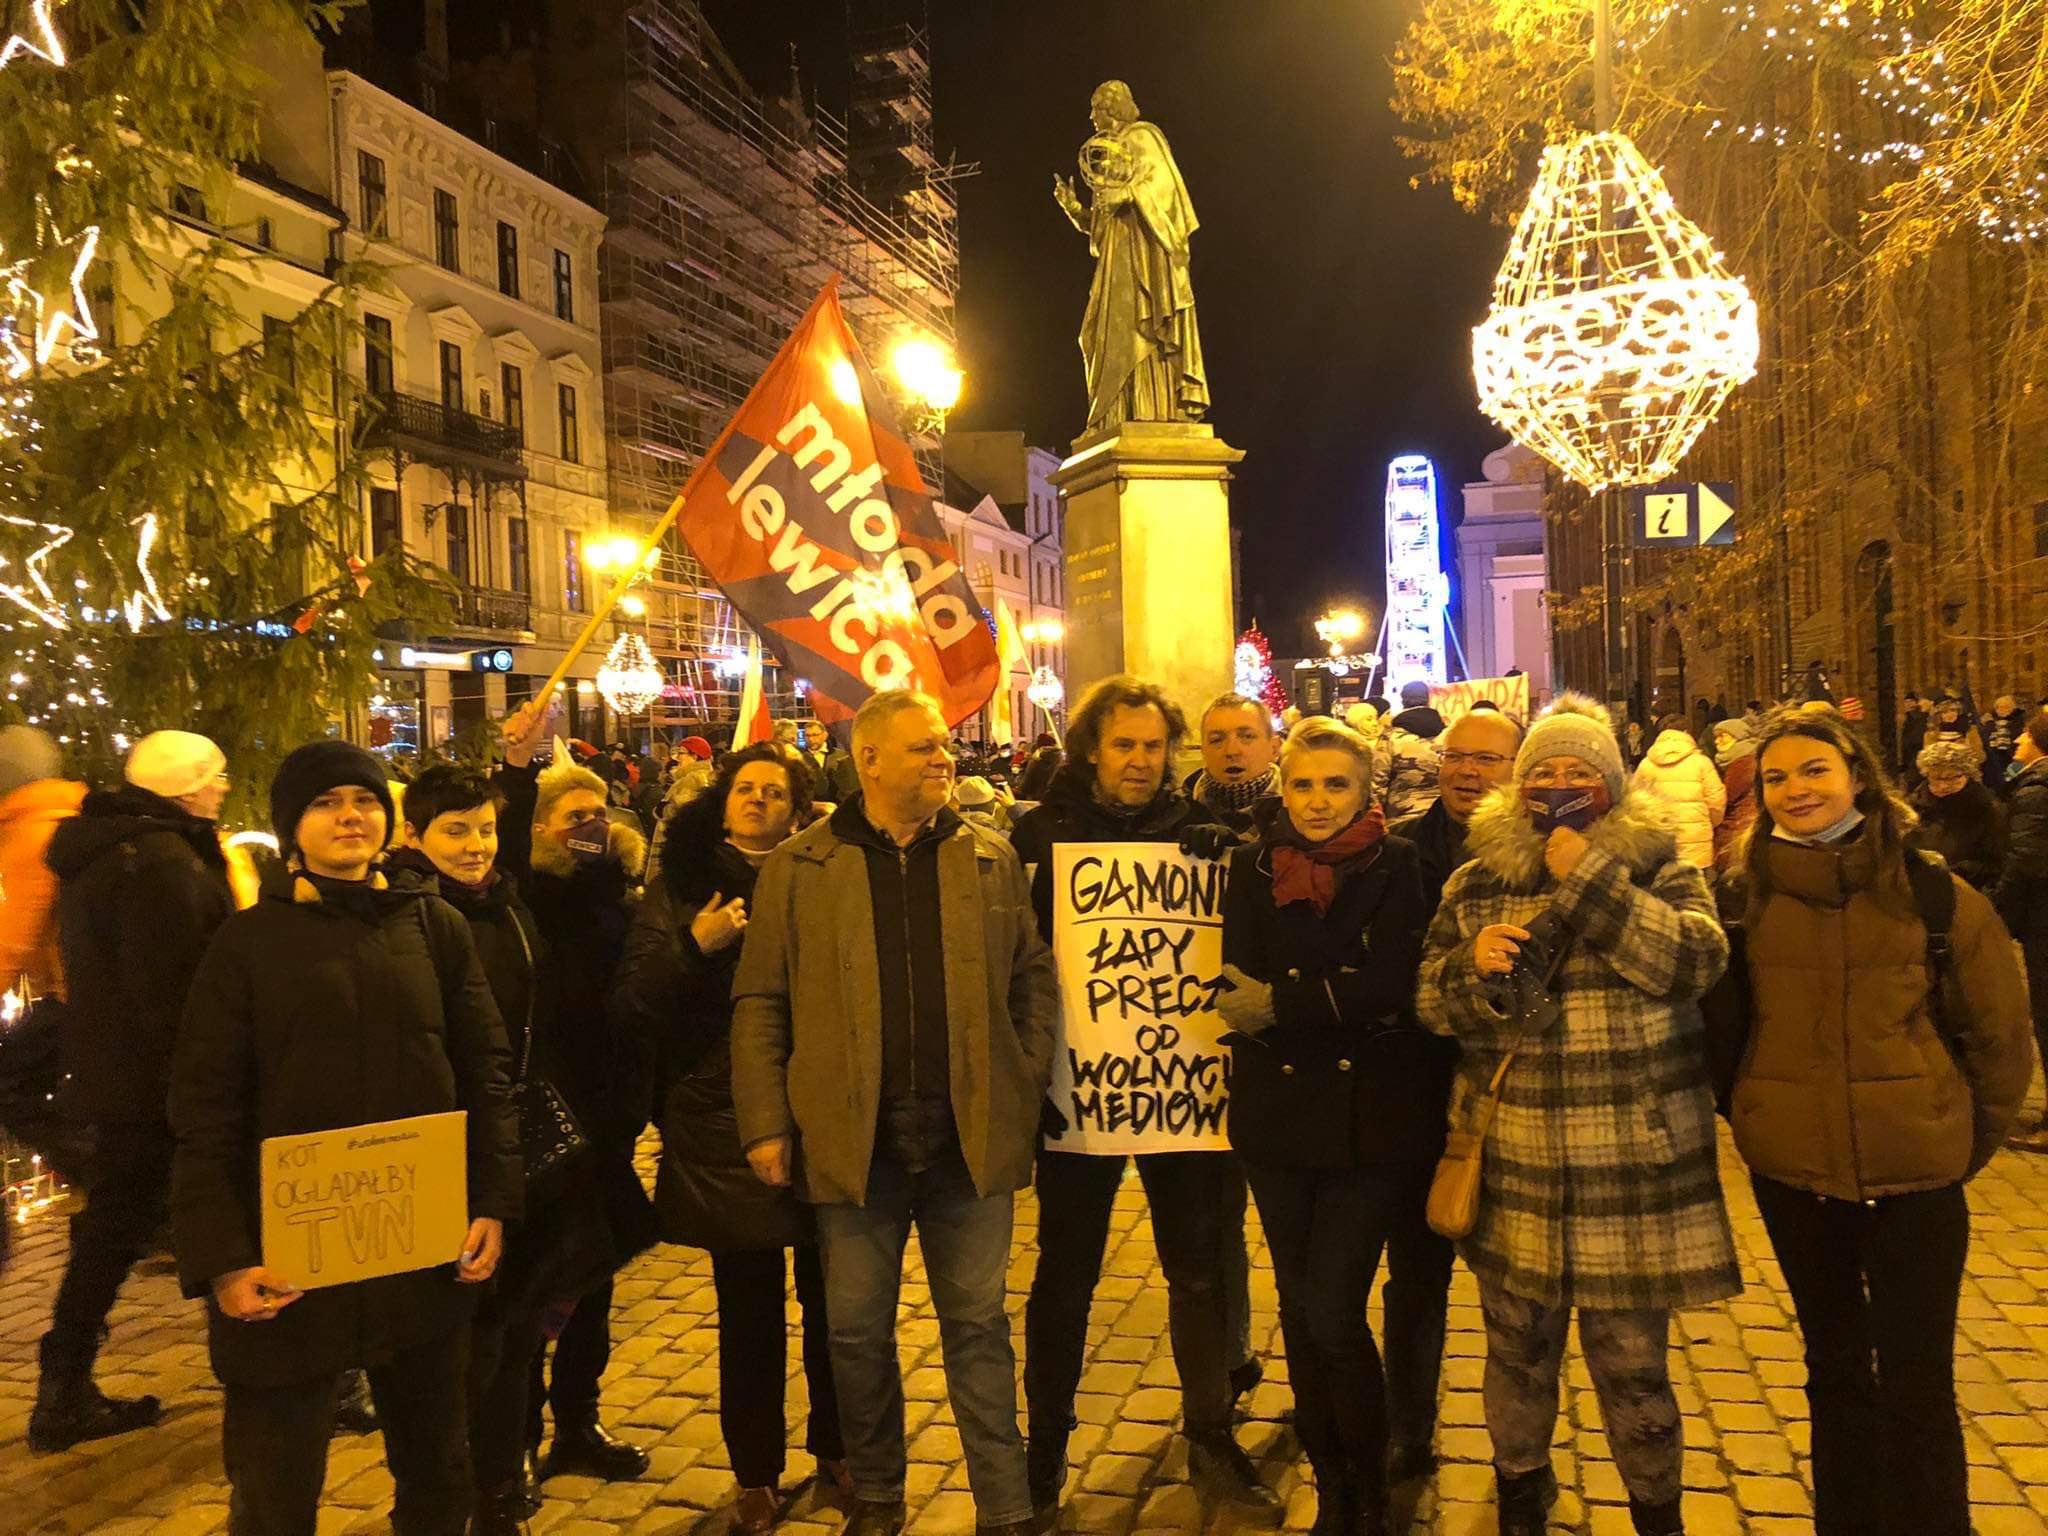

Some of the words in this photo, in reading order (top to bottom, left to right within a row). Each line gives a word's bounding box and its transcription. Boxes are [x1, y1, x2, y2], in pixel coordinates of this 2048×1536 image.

[776, 402, 978, 651] młoda
[726, 443, 916, 693] lewica
[1087, 927, 1196, 976] ŁAPY
[1136, 1024, 1181, 1056] OD
[277, 1141, 322, 1171] KOT
[285, 1194, 416, 1275] TVN
